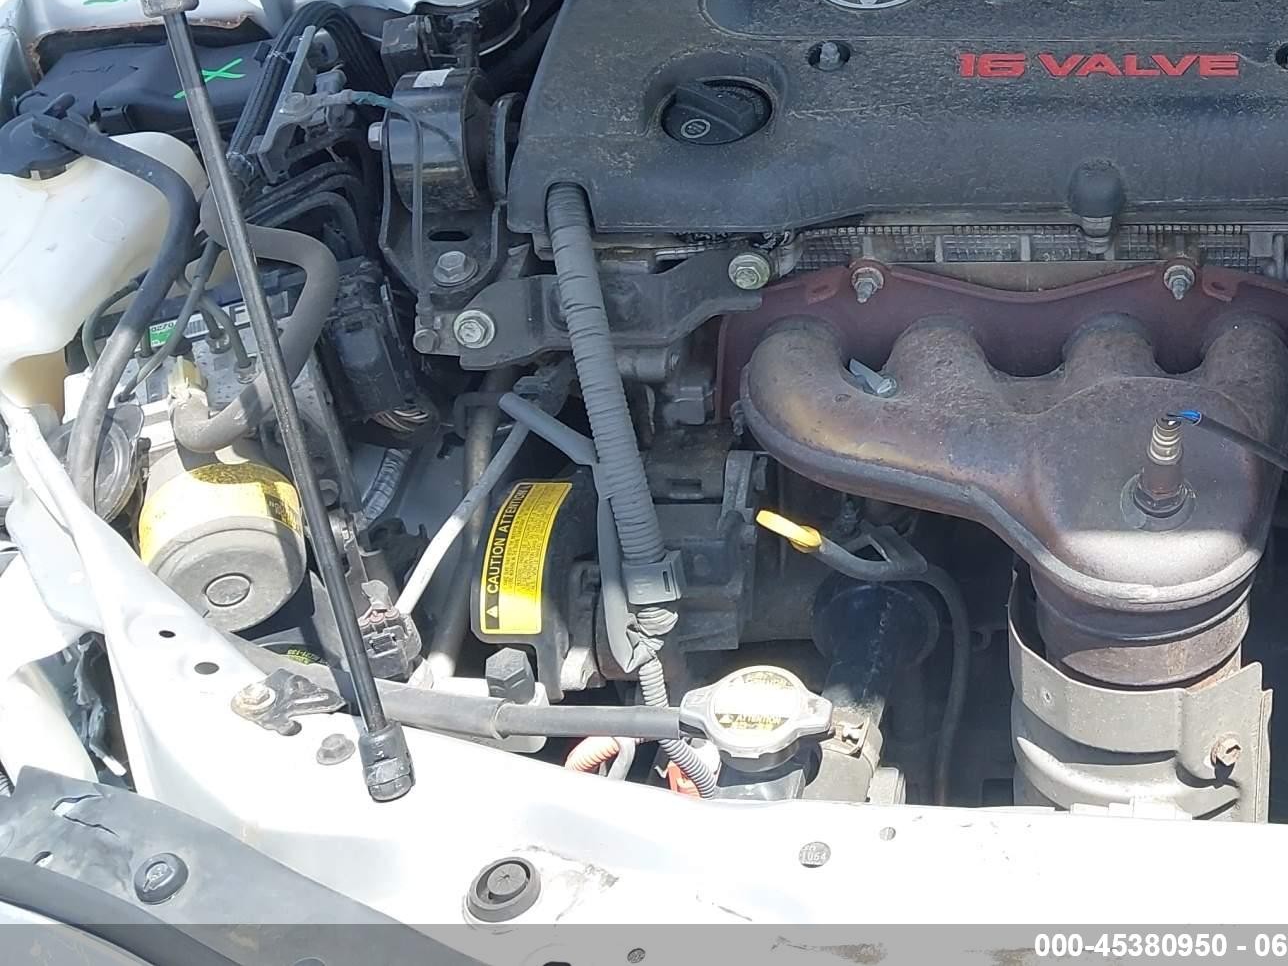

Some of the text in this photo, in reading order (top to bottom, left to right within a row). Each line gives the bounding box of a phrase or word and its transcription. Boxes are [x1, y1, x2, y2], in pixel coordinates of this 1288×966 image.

[959, 52, 1240, 78] 16 VALVE
[487, 537, 506, 594] CAUTION
